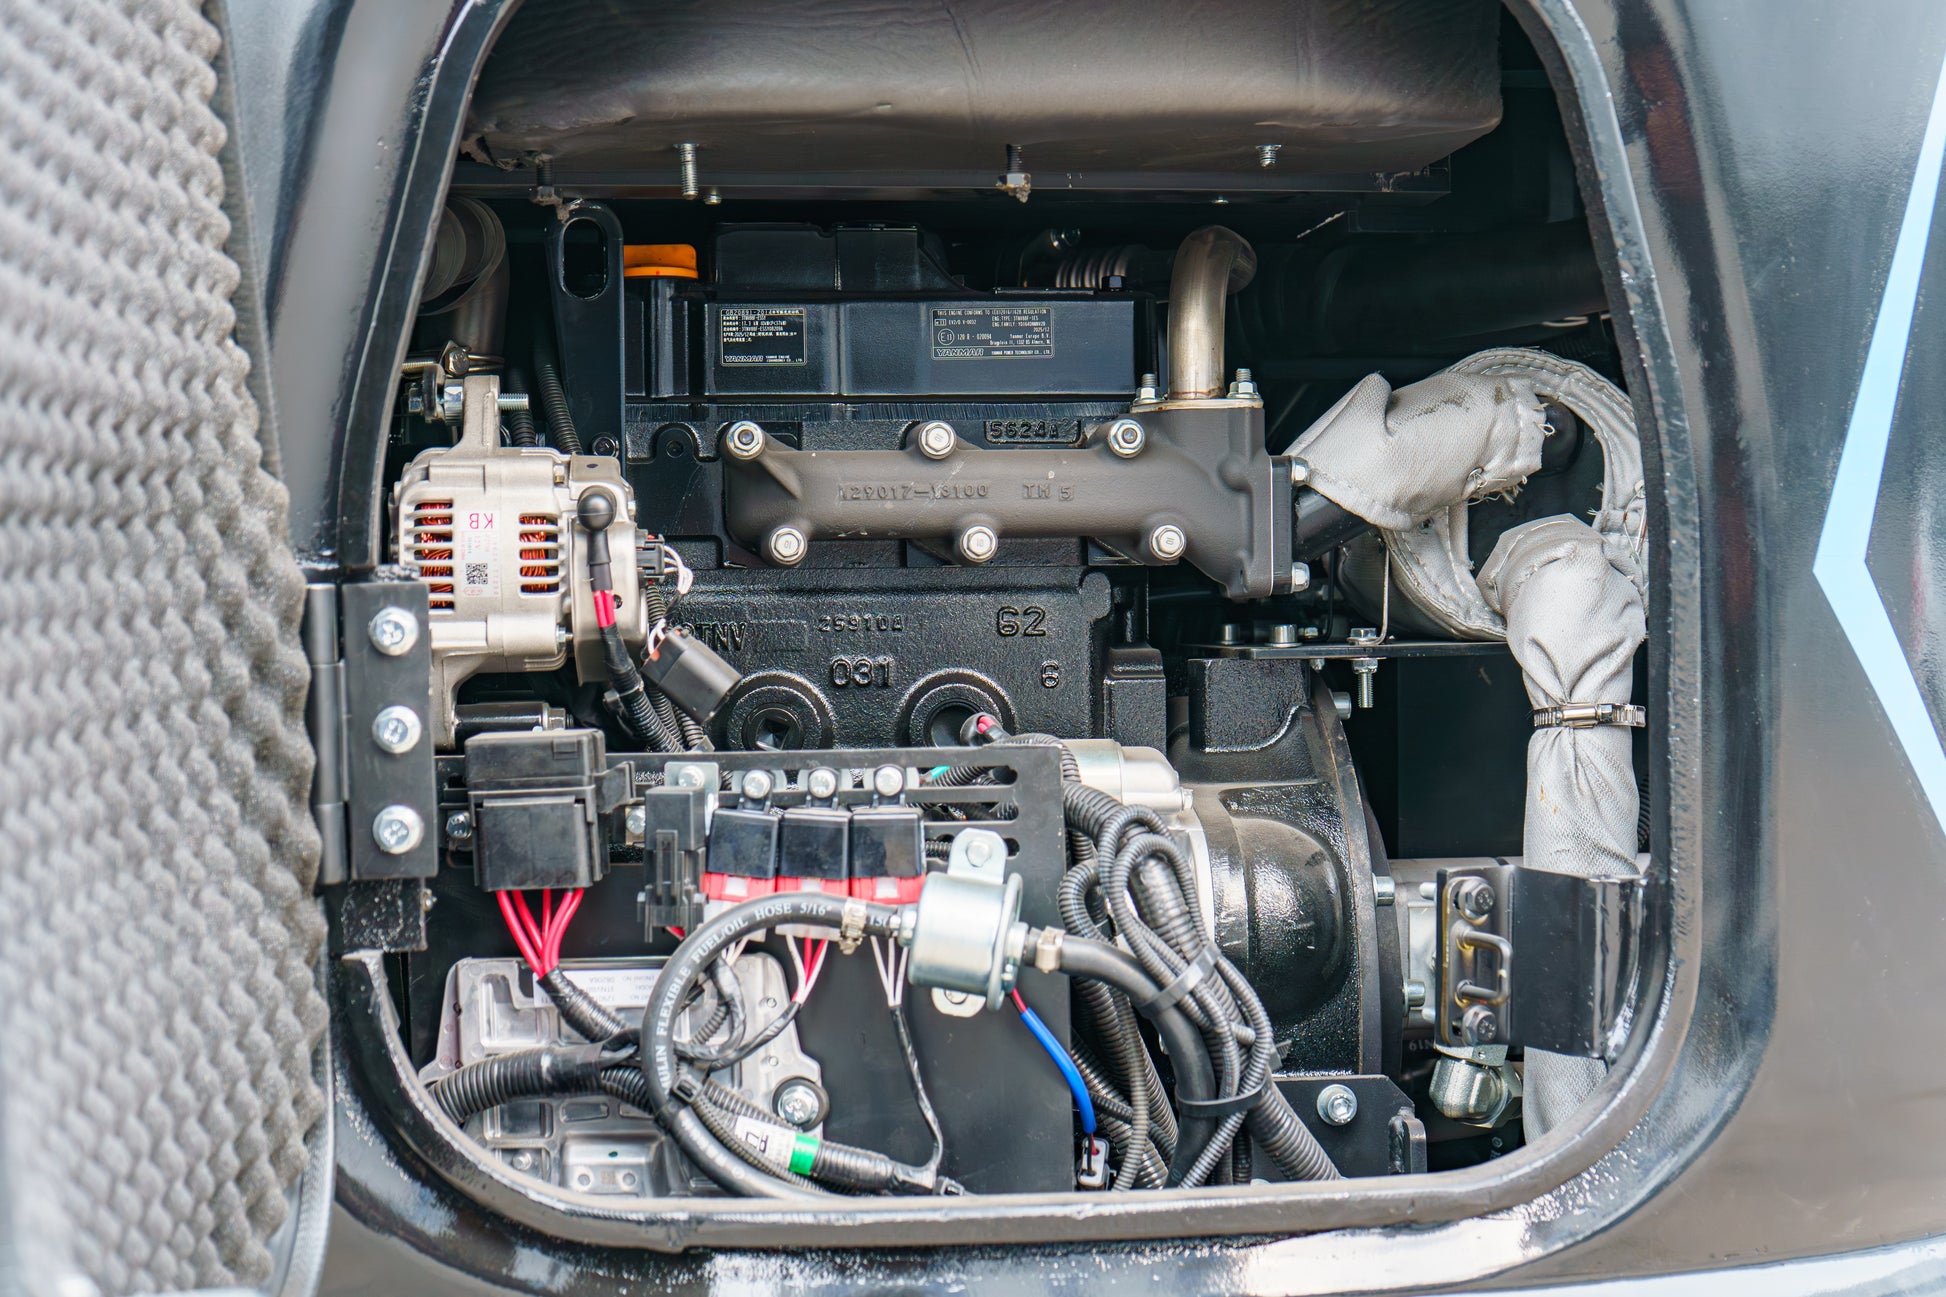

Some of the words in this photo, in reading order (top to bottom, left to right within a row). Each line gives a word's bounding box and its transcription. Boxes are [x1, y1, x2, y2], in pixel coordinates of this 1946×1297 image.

[937, 348, 984, 356] YANMAR
[469, 512, 494, 530] KB
[997, 606, 1046, 636] 62
[830, 655, 895, 686] 031
[1042, 660, 1060, 688] 6
[656, 967, 692, 1036] FLEXIBLE
[691, 918, 748, 964] FUEL/OIL
[754, 902, 793, 922] HOSE
